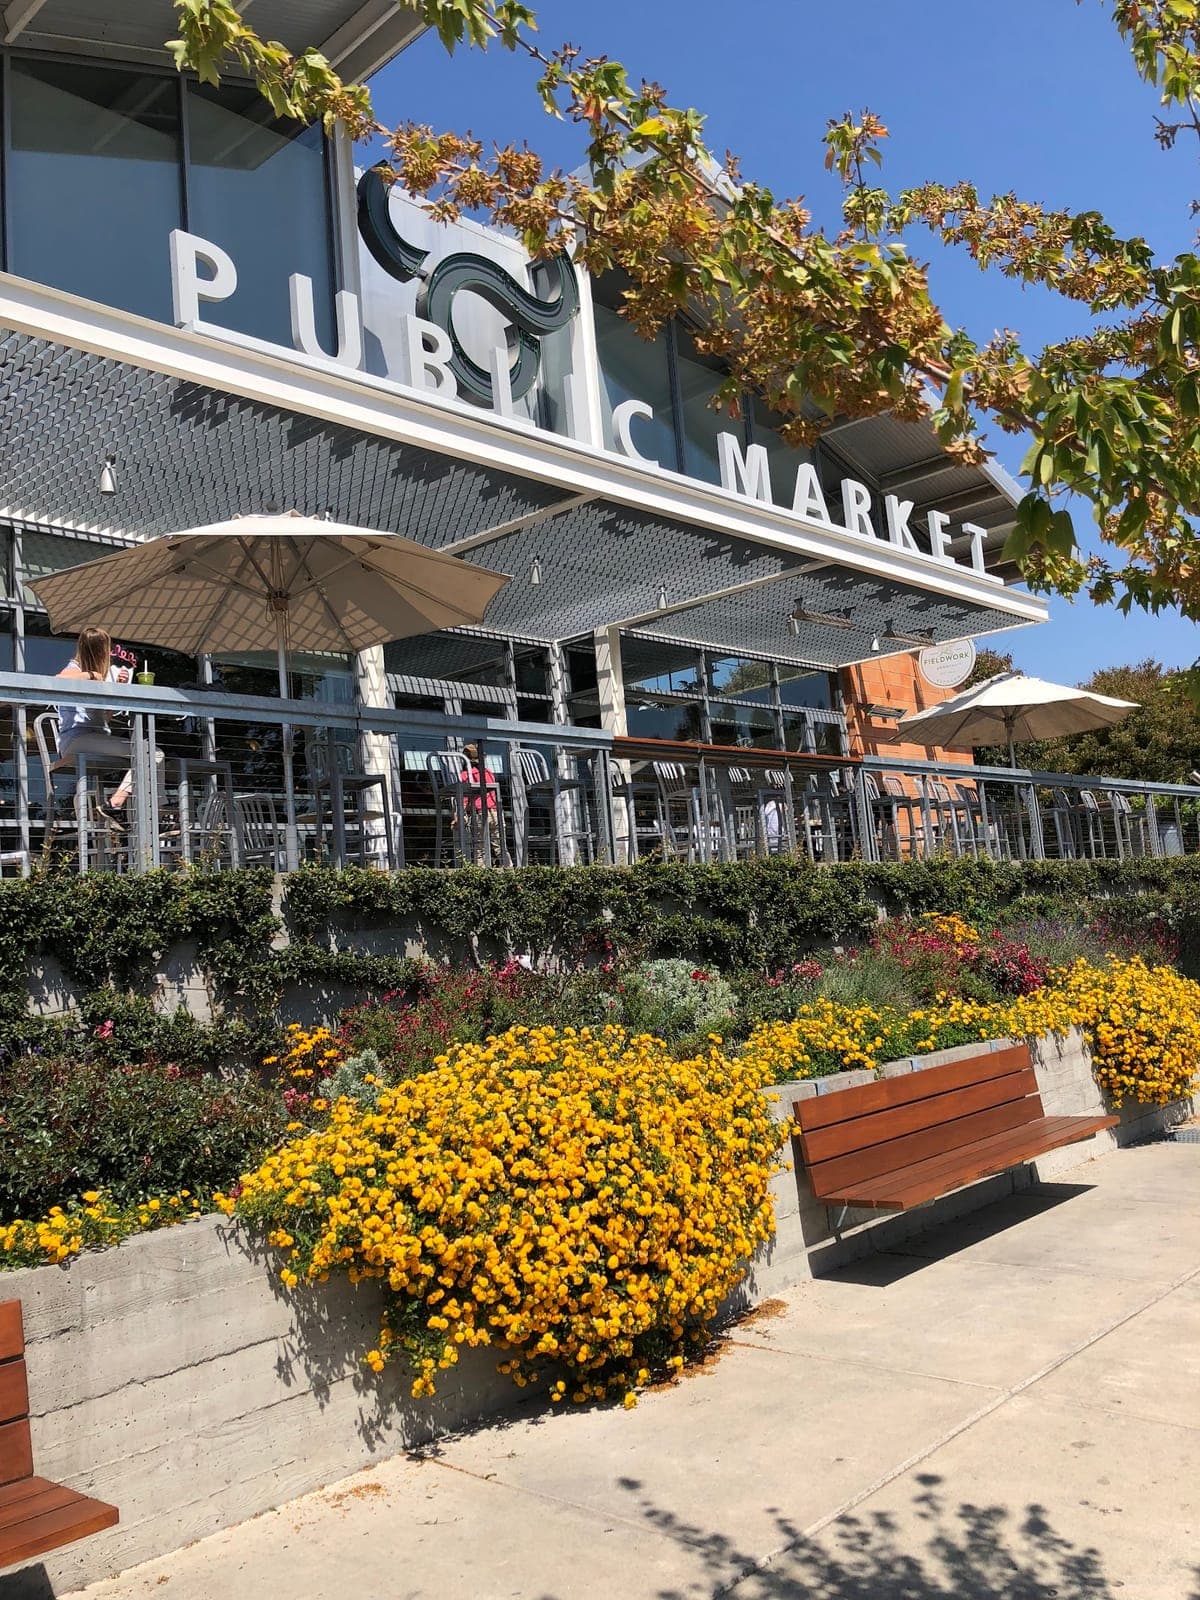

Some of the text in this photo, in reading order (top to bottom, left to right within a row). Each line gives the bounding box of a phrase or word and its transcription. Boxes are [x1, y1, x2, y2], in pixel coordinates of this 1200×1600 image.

[169, 229, 988, 574] PUBLIC MARKET
[923, 651, 970, 665] FIELDWORK
